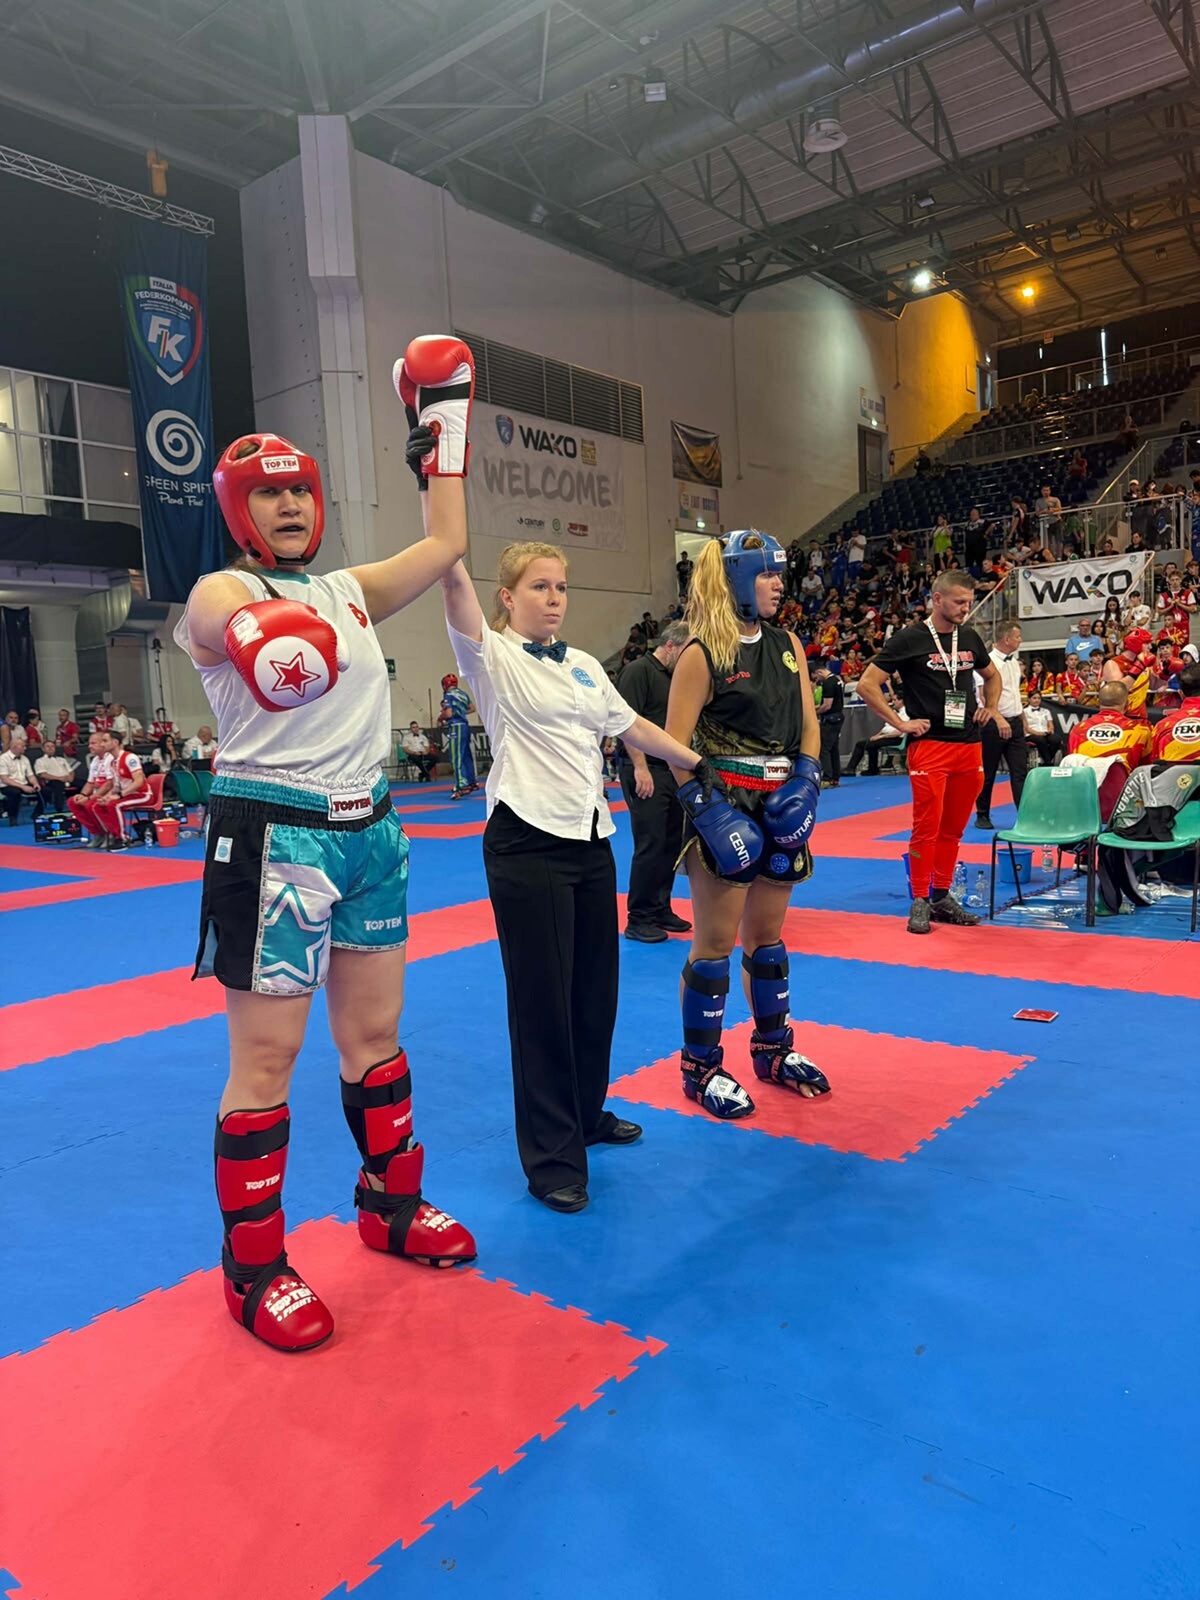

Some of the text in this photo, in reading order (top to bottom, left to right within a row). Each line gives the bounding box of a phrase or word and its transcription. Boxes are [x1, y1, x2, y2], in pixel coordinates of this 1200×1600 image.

[152, 280, 174, 291] ITALIA
[135, 290, 194, 312] FEDERKOMBAT
[518, 425, 577, 459] WAKO
[265, 461, 281, 469] TOP
[483, 457, 612, 508] WELCOME
[1029, 569, 1133, 604] WAKO
[1089, 729, 1120, 741] FEKM
[774, 811, 813, 844] CENTURY
[729, 831, 750, 868] CENTU
[364, 916, 402, 931] TOP TEN
[245, 1181, 265, 1190] TOP
[268, 1295, 291, 1316] TOP
